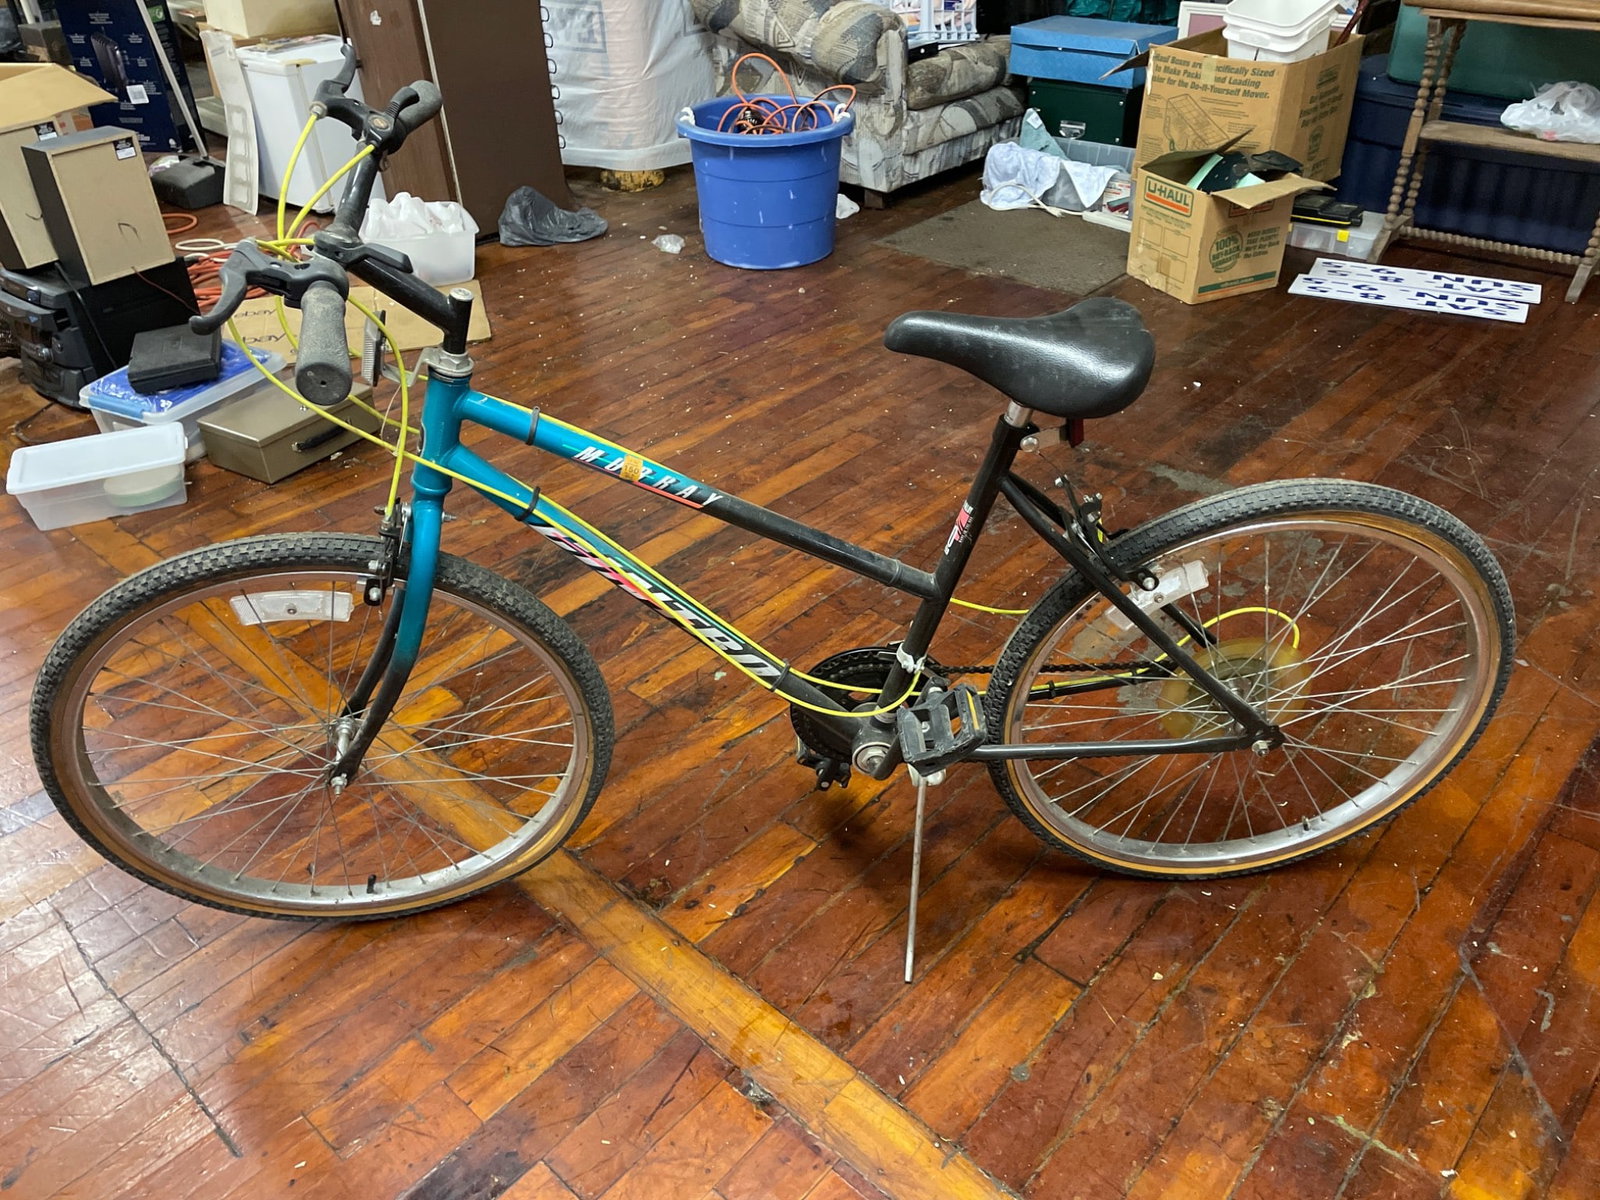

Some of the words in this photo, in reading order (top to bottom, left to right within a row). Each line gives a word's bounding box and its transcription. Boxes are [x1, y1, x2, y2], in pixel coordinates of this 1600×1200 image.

[1163, 65, 1181, 76] Make
[1182, 69, 1202, 80] Packi
[1228, 76, 1261, 89] Loading
[1215, 64, 1249, 76] cifically
[1250, 67, 1276, 77] Sized
[1167, 77, 1177, 86] for
[1178, 78, 1189, 88] the
[1241, 89, 1270, 99] Mover.
[1147, 181, 1190, 206] U-HAUL
[1215, 235, 1241, 251] 100%
[241, 333, 286, 344] bay
